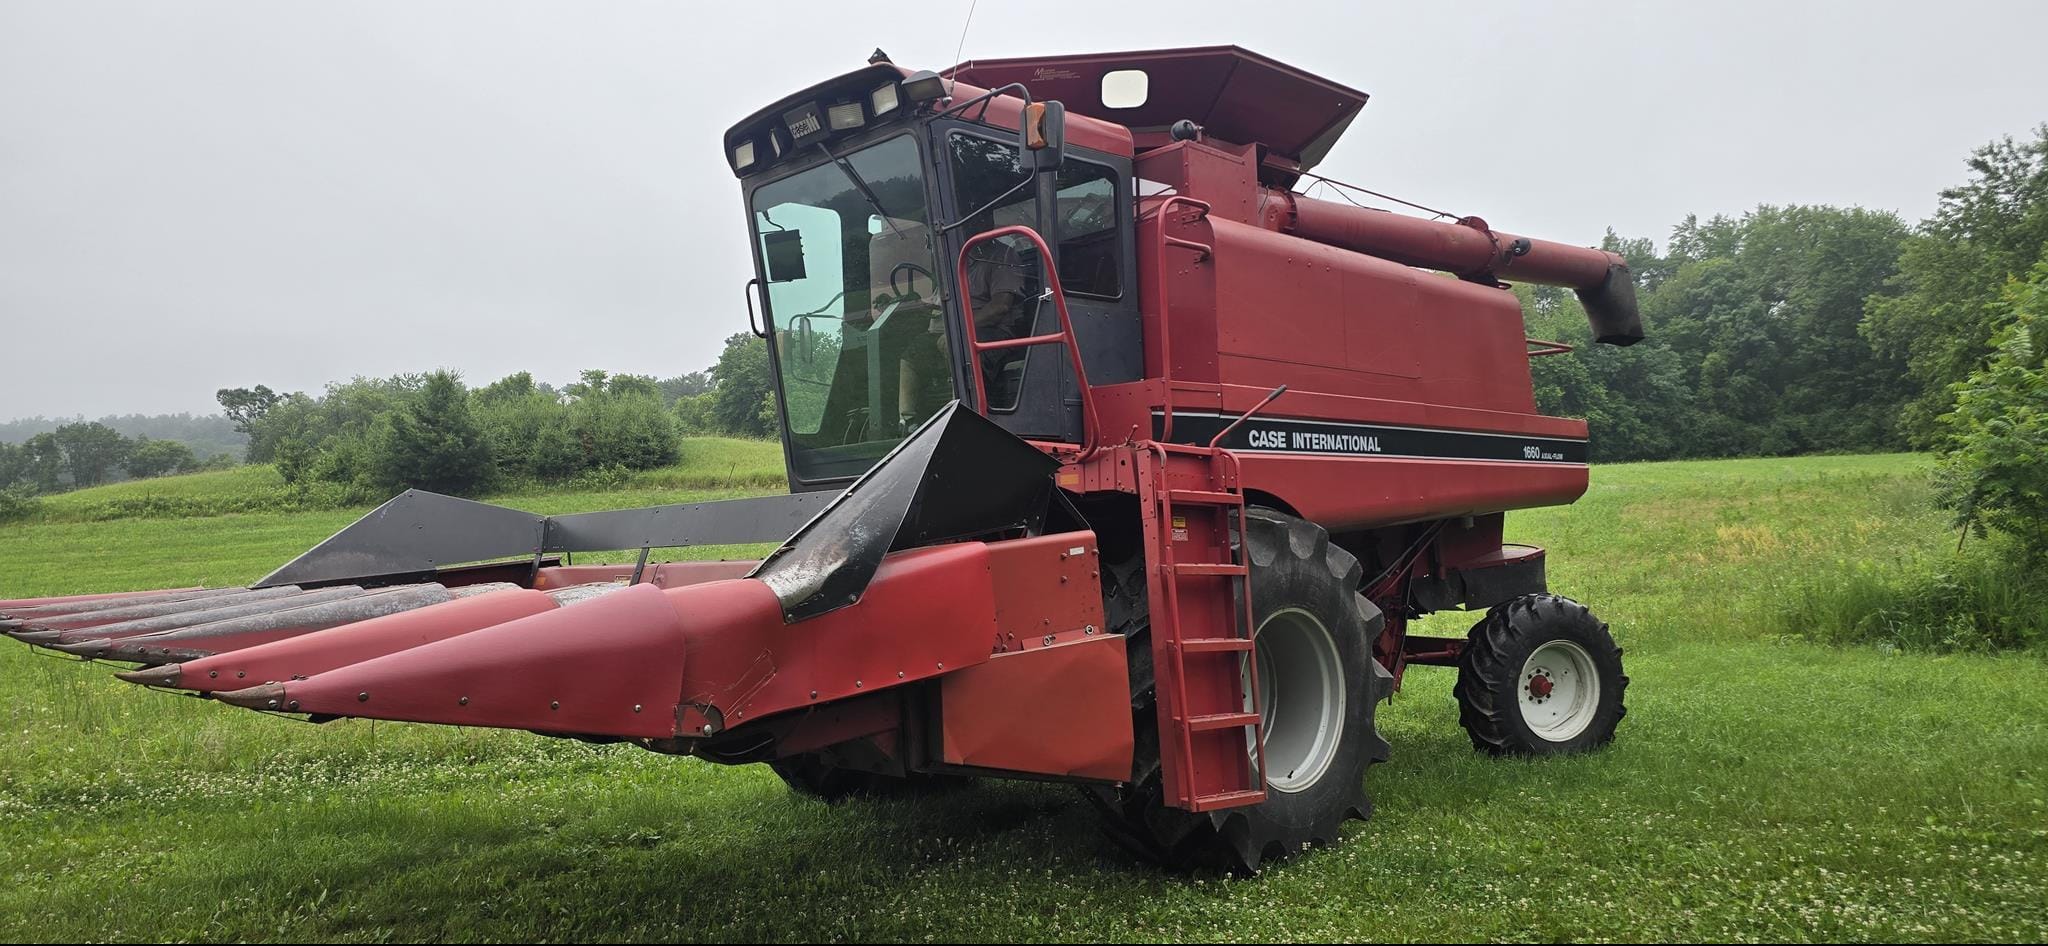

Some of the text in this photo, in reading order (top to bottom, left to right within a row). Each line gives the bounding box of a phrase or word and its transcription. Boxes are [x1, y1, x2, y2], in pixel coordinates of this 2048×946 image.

[1248, 429, 1382, 452] CASE INTERNATIONAL
[1523, 445, 1540, 459] 1660
